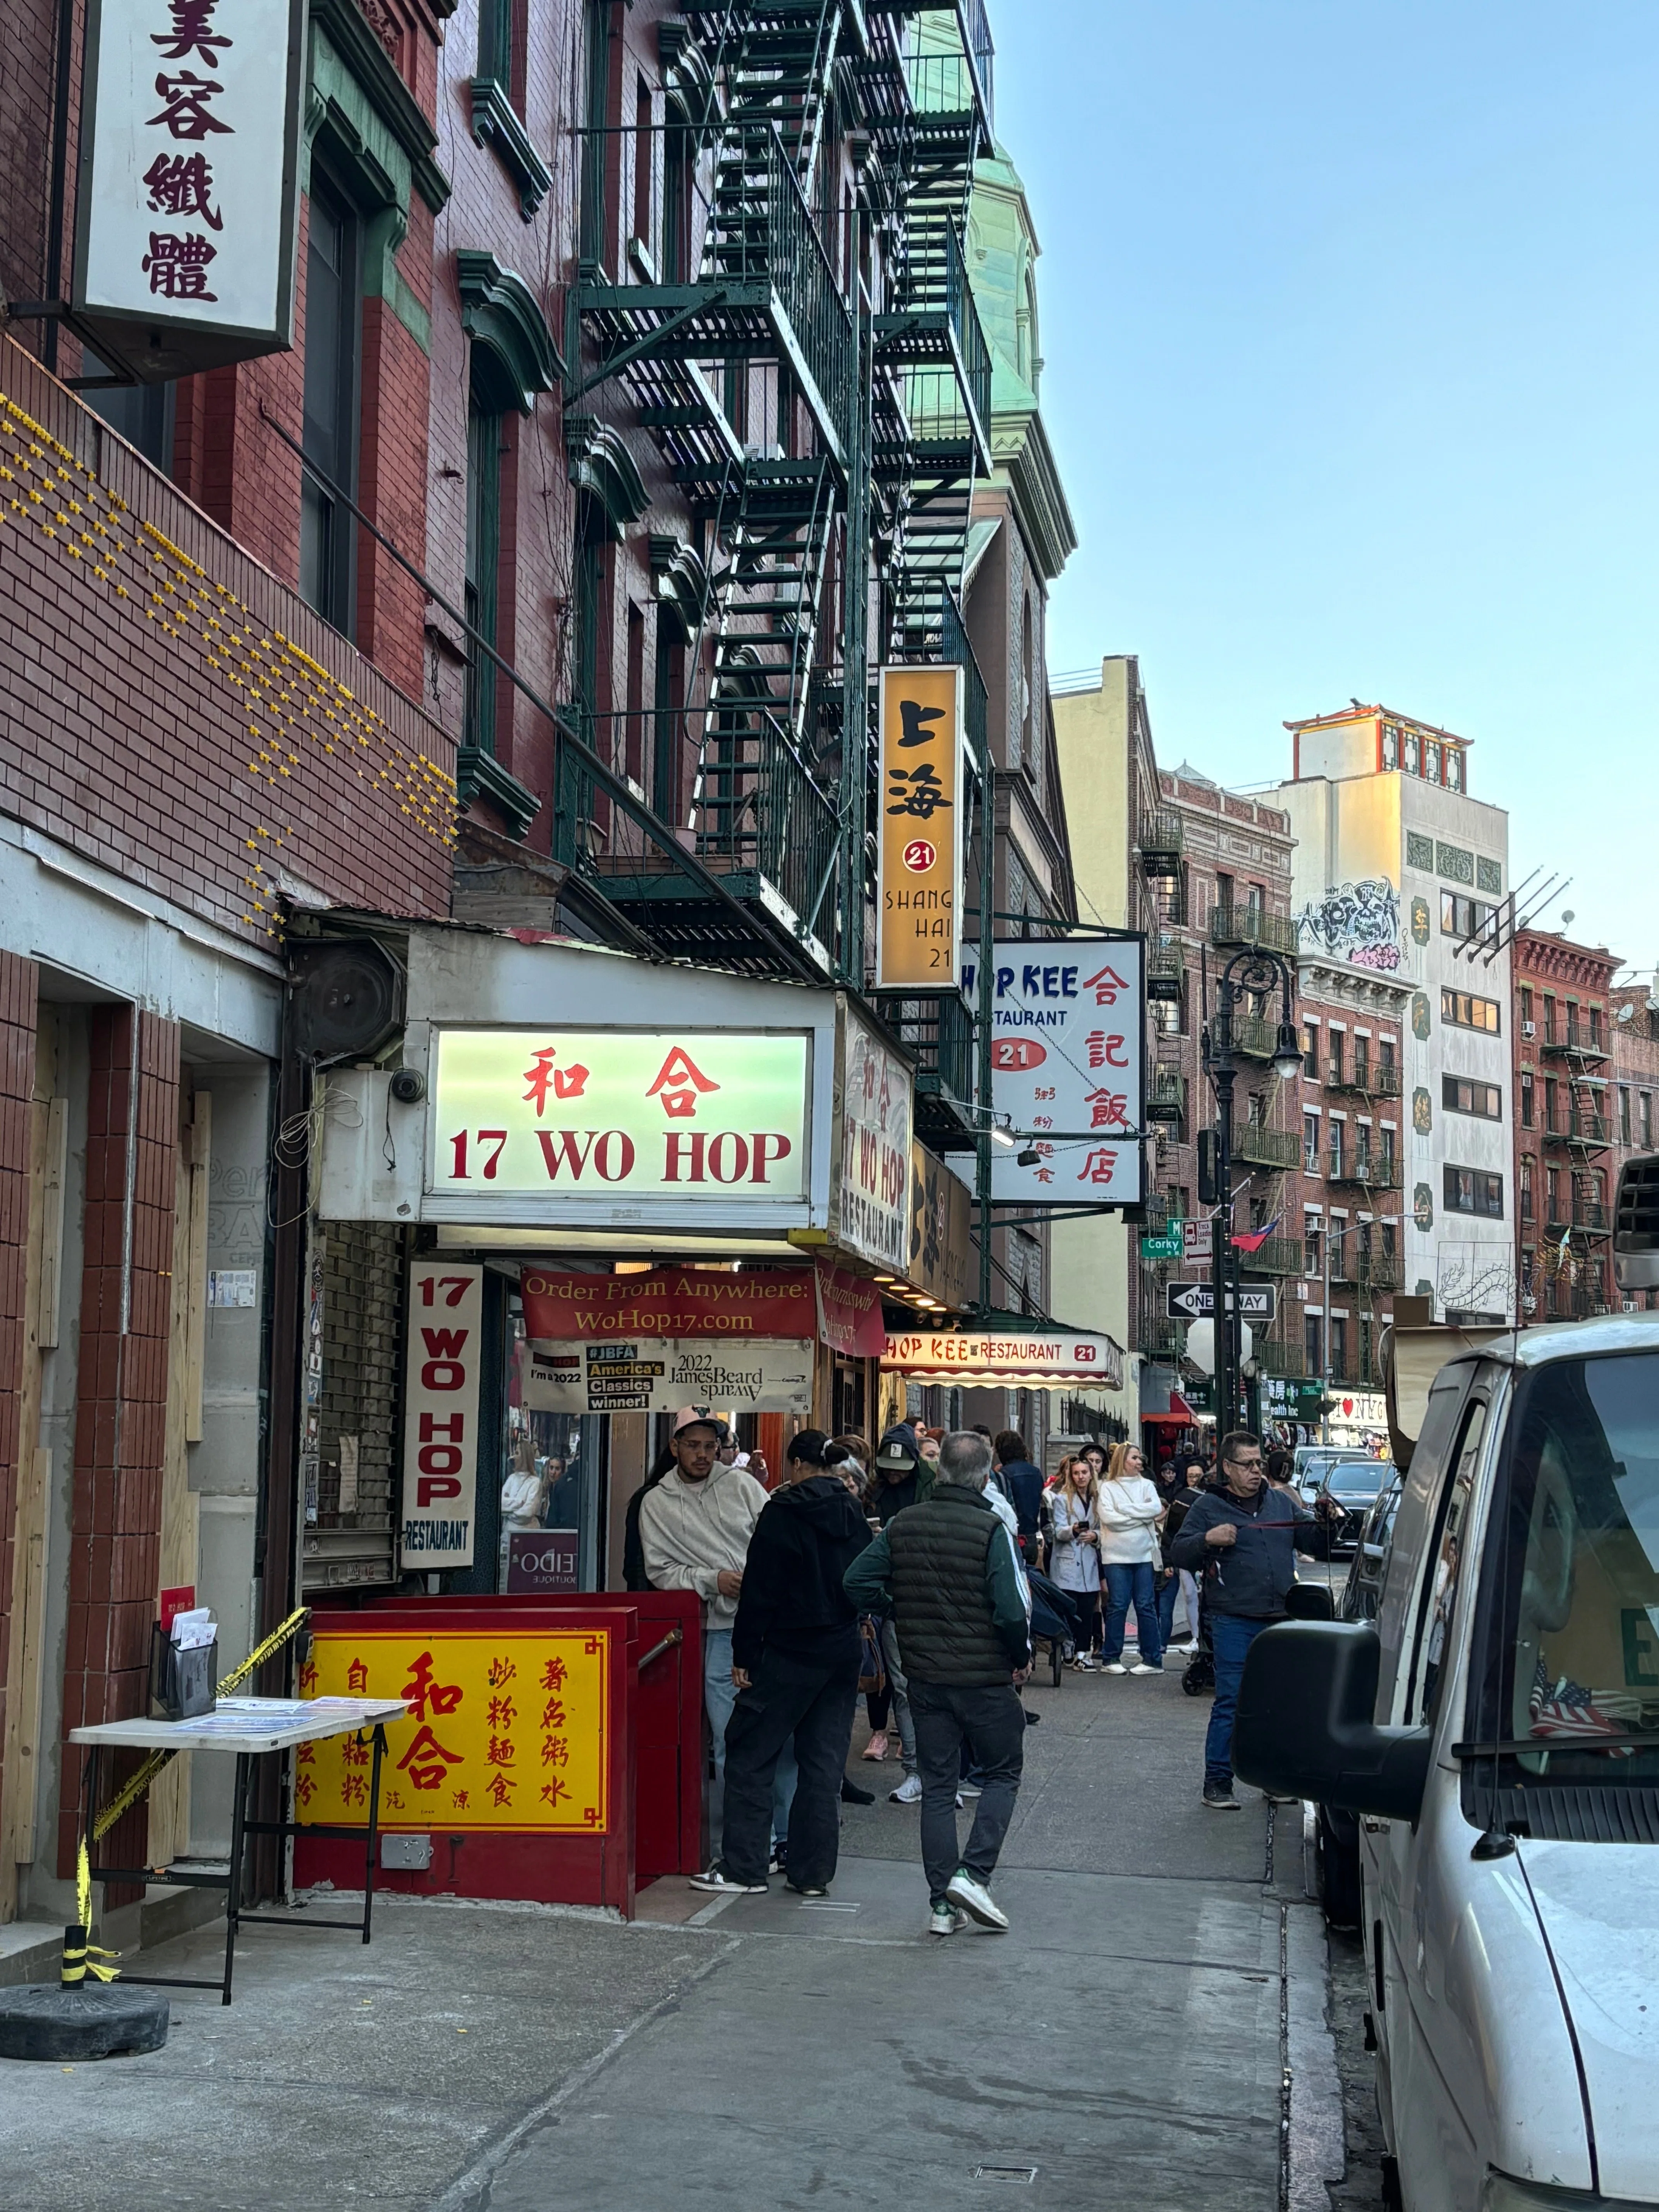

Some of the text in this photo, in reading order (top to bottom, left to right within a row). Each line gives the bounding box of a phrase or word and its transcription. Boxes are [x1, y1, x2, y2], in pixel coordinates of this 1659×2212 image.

[142, 0, 235, 302] 美容纖體
[886, 701, 953, 820] 上海
[907, 846, 930, 865] 21
[886, 890, 952, 909] SHANG
[916, 918, 950, 938] HAI
[929, 949, 950, 967] 21
[962, 965, 1078, 998] HP KEE
[999, 1044, 1029, 1065] 21
[522, 1046, 720, 1118] 和合
[1077, 966, 1130, 1184] 合記飯店
[448, 1129, 791, 1183] 17 WO HOP
[860, 1125, 877, 1195] WO
[881, 1142, 905, 1210] HOP
[842, 1188, 903, 1262] RESTAURANT
[1148, 1239, 1179, 1250] Corky
[417, 1277, 475, 1307] 17
[526, 1276, 599, 1300] Order
[606, 1278, 666, 1299] From
[673, 1276, 808, 1302] Anywhere:
[1185, 1294, 1213, 1308] ONE
[575, 1309, 753, 1333] WoHop17.com
[421, 1328, 469, 1390] WO
[589, 1346, 635, 1360] #JBFA
[886, 1337, 1094, 1361] HOP KEE RESTAURANT 21
[590, 1362, 662, 1376] America's
[678, 1355, 712, 1371] 2022
[531, 1369, 546, 1379] I'm
[554, 1374, 581, 1383] 2022
[591, 1379, 651, 1392] Classics
[591, 1395, 646, 1408] winner!
[701, 1385, 763, 1401] Awards
[1271, 1403, 1286, 1416] ealth
[417, 1413, 464, 1507] HOP
[405, 1520, 469, 1551] RESTAURANT
[341, 1657, 370, 1807] 自粘粉
[396, 1651, 465, 1790] 和合
[484, 1656, 518, 1808] 炒粉麵食
